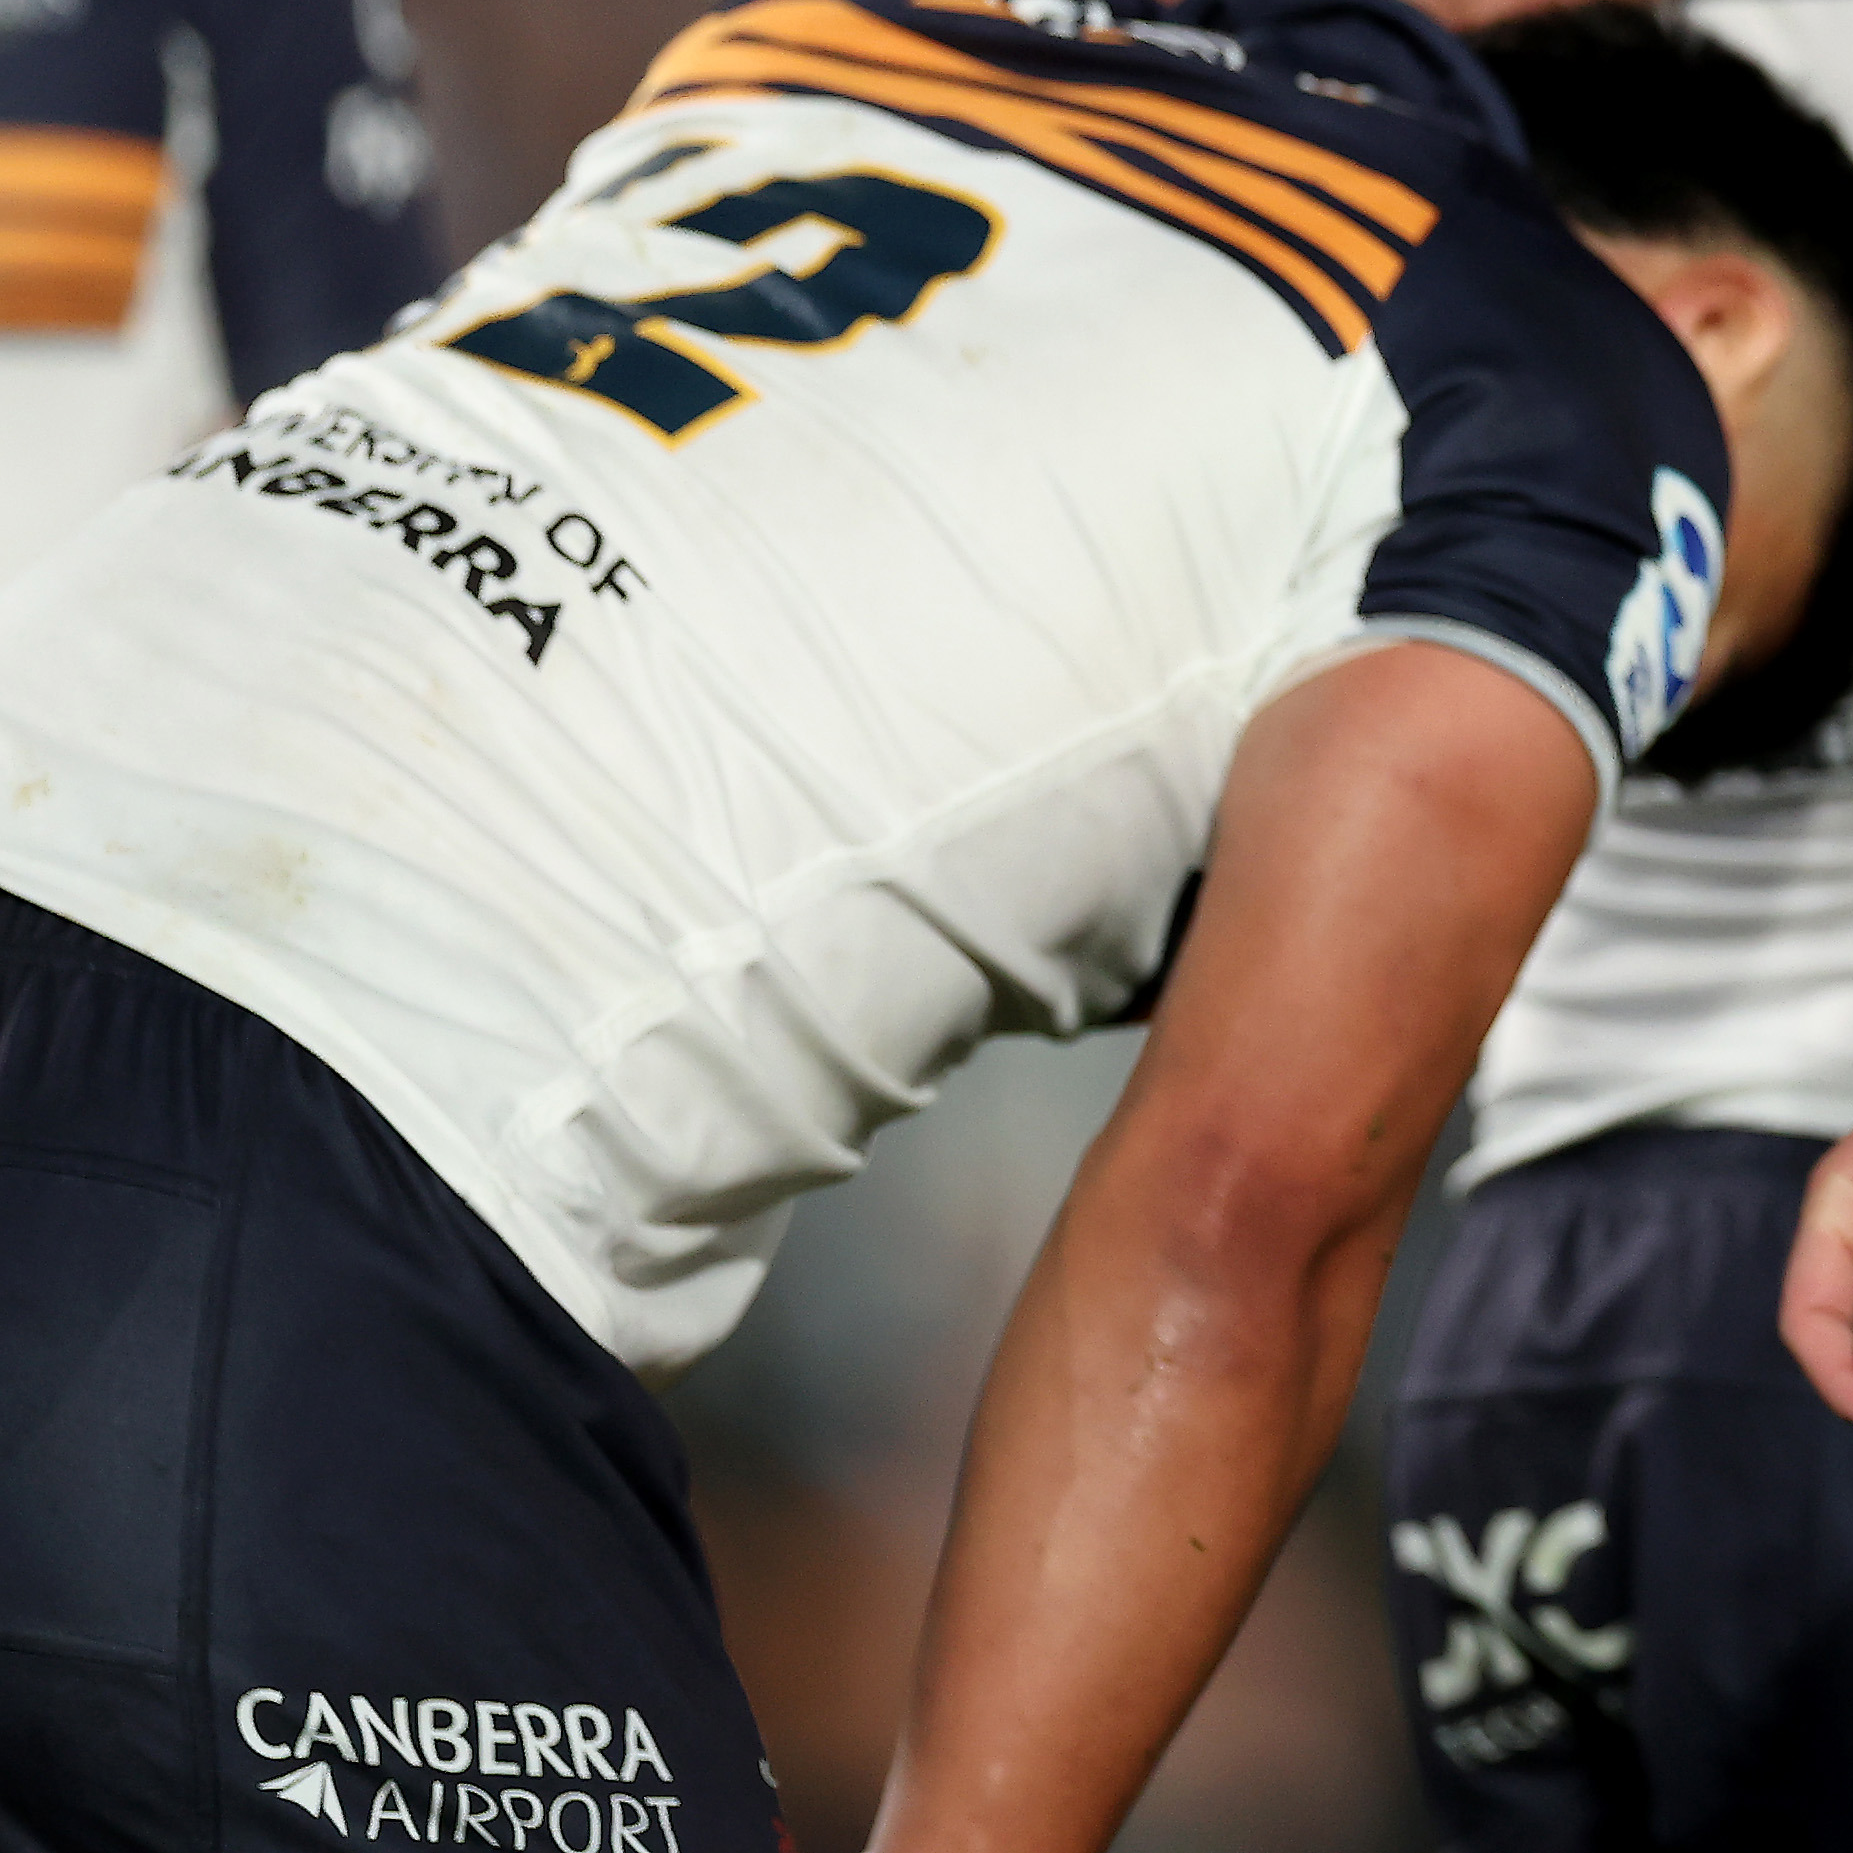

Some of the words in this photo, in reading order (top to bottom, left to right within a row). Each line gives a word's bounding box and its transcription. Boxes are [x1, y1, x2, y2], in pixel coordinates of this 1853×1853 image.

[167, 448, 563, 668] NBERRA
[545, 511, 650, 602] OF
[235, 1687, 676, 1783] CANBERRA
[366, 1778, 683, 1853] AIRPORT
